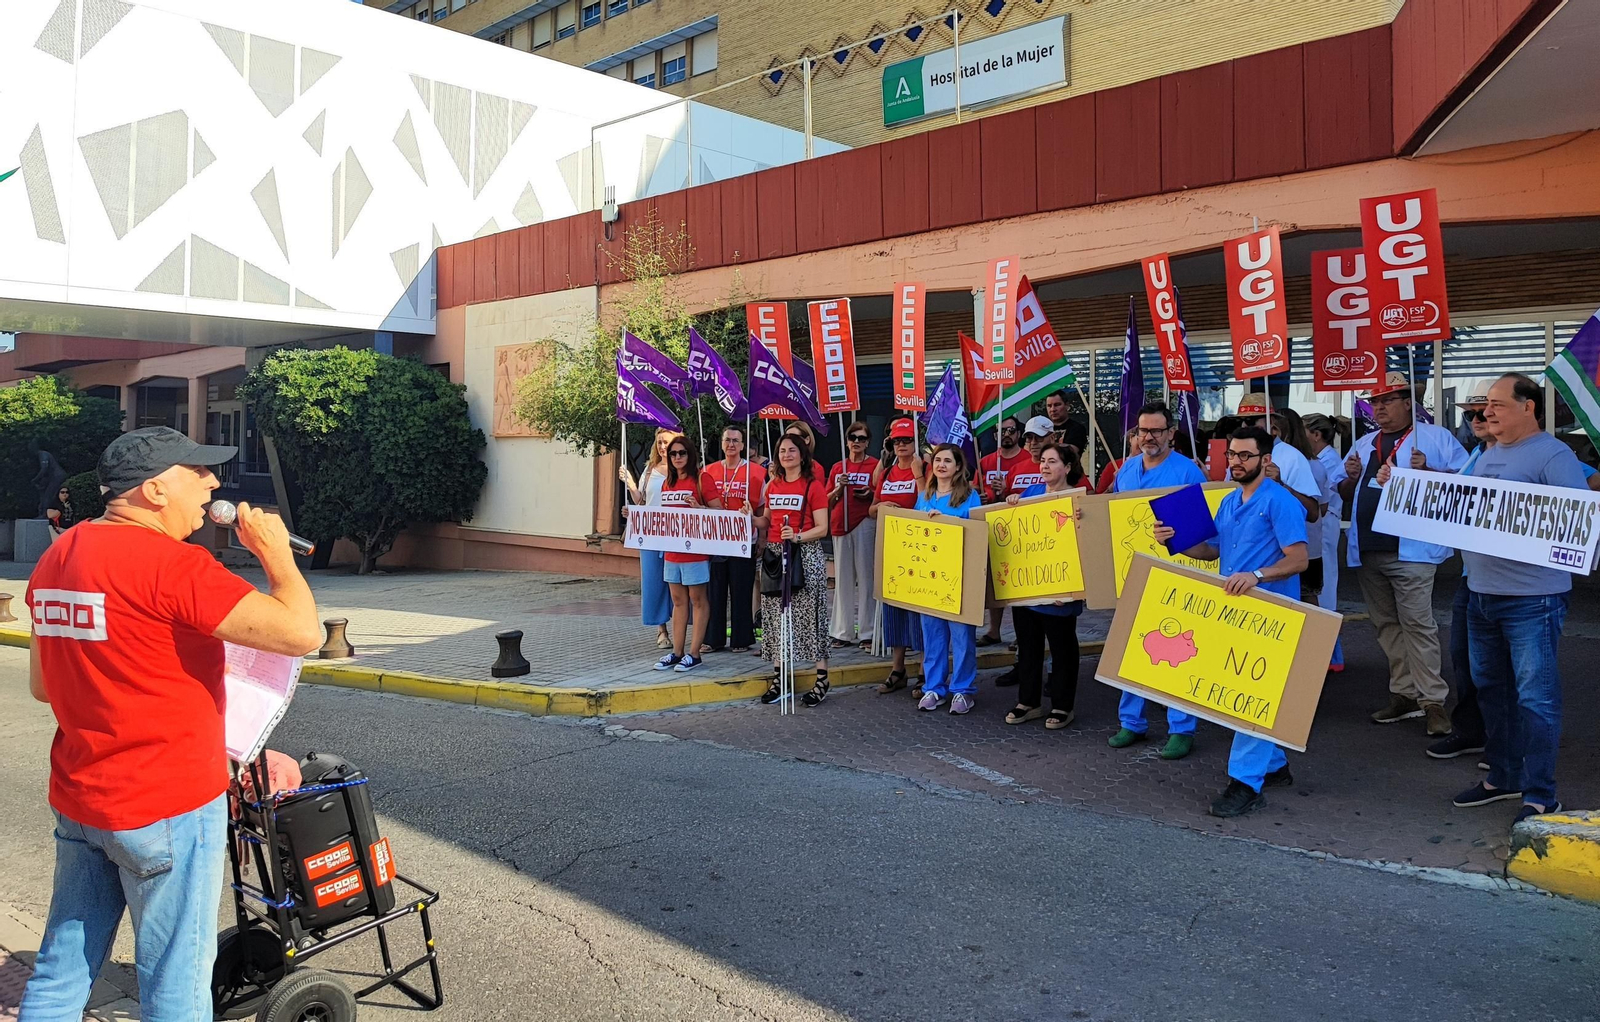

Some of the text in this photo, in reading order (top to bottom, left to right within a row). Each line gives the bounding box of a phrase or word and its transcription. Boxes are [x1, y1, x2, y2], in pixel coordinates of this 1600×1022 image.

[984, 59, 999, 73] de
[1002, 55, 1013, 69] la
[1017, 44, 1055, 65] Mujer
[1376, 198, 1429, 301] UGT
[1238, 235, 1276, 336] UGT
[993, 260, 1010, 343] CCOO
[1149, 260, 1177, 352] UGT
[1327, 254, 1371, 350] UGT
[1383, 308, 1404, 320] UGT
[1410, 306, 1426, 315] FSP
[902, 286, 916, 370] CCOO
[820, 303, 846, 384] CCOO
[1015, 332, 1057, 367] evilla
[1263, 340, 1275, 349] FSP
[985, 367, 1014, 381] Sevilla
[1326, 357, 1346, 368] UGT
[896, 394, 925, 408] Sevilla
[770, 497, 800, 507] CCOO
[1384, 476, 1596, 547] NO AL RECORTE DE ANESTESISTAS
[643, 511, 680, 538] QUEREMOS
[682, 514, 701, 539] PARIR
[703, 515, 718, 540] CON
[720, 516, 748, 542] DOLOR!
[905, 524, 943, 537] STOP
[1019, 514, 1040, 537] NO
[902, 541, 939, 553] PARTO
[1013, 533, 1057, 560] al parto
[1550, 547, 1585, 567] CCOO
[911, 555, 928, 563] CON
[908, 586, 939, 596] JUANMA
[1160, 586, 1287, 643] LA SALUD MATERNAL
[1224, 647, 1267, 681] NO
[1186, 675, 1271, 723] SE RECORTA
[308, 851, 341, 870] CCOO
[327, 855, 351, 869] Sevilla
[318, 877, 350, 897] CCOO
[336, 883, 360, 896] Sevilla
